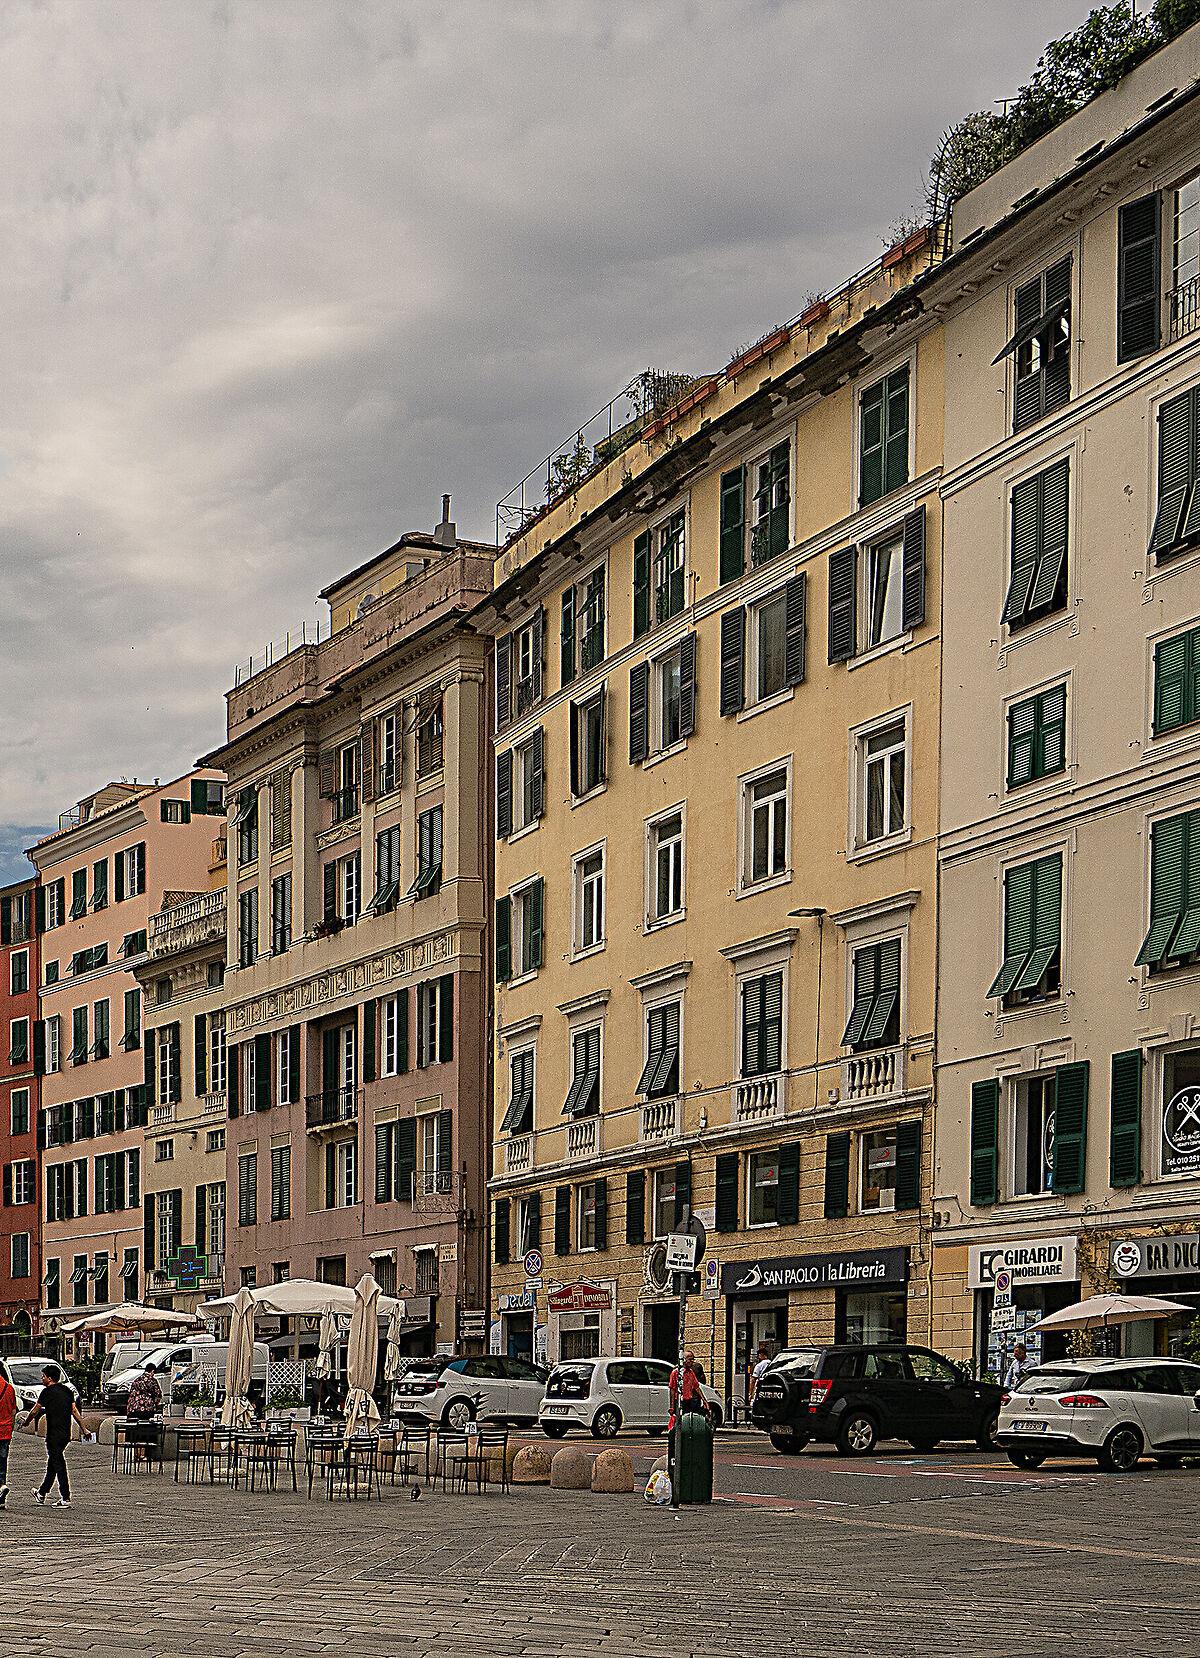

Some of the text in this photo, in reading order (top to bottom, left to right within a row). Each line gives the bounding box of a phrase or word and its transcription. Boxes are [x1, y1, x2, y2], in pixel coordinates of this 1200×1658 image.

[1177, 1156, 1188, 1164] 010
[1004, 1245, 1063, 1266] GIRARDI
[1146, 1242, 1169, 1270] BAR
[763, 1260, 886, 1286] SAN PAOLO la Libreria
[1012, 1264, 1062, 1278] MOBILIARE
[758, 1391, 784, 1399] SUZUKI
